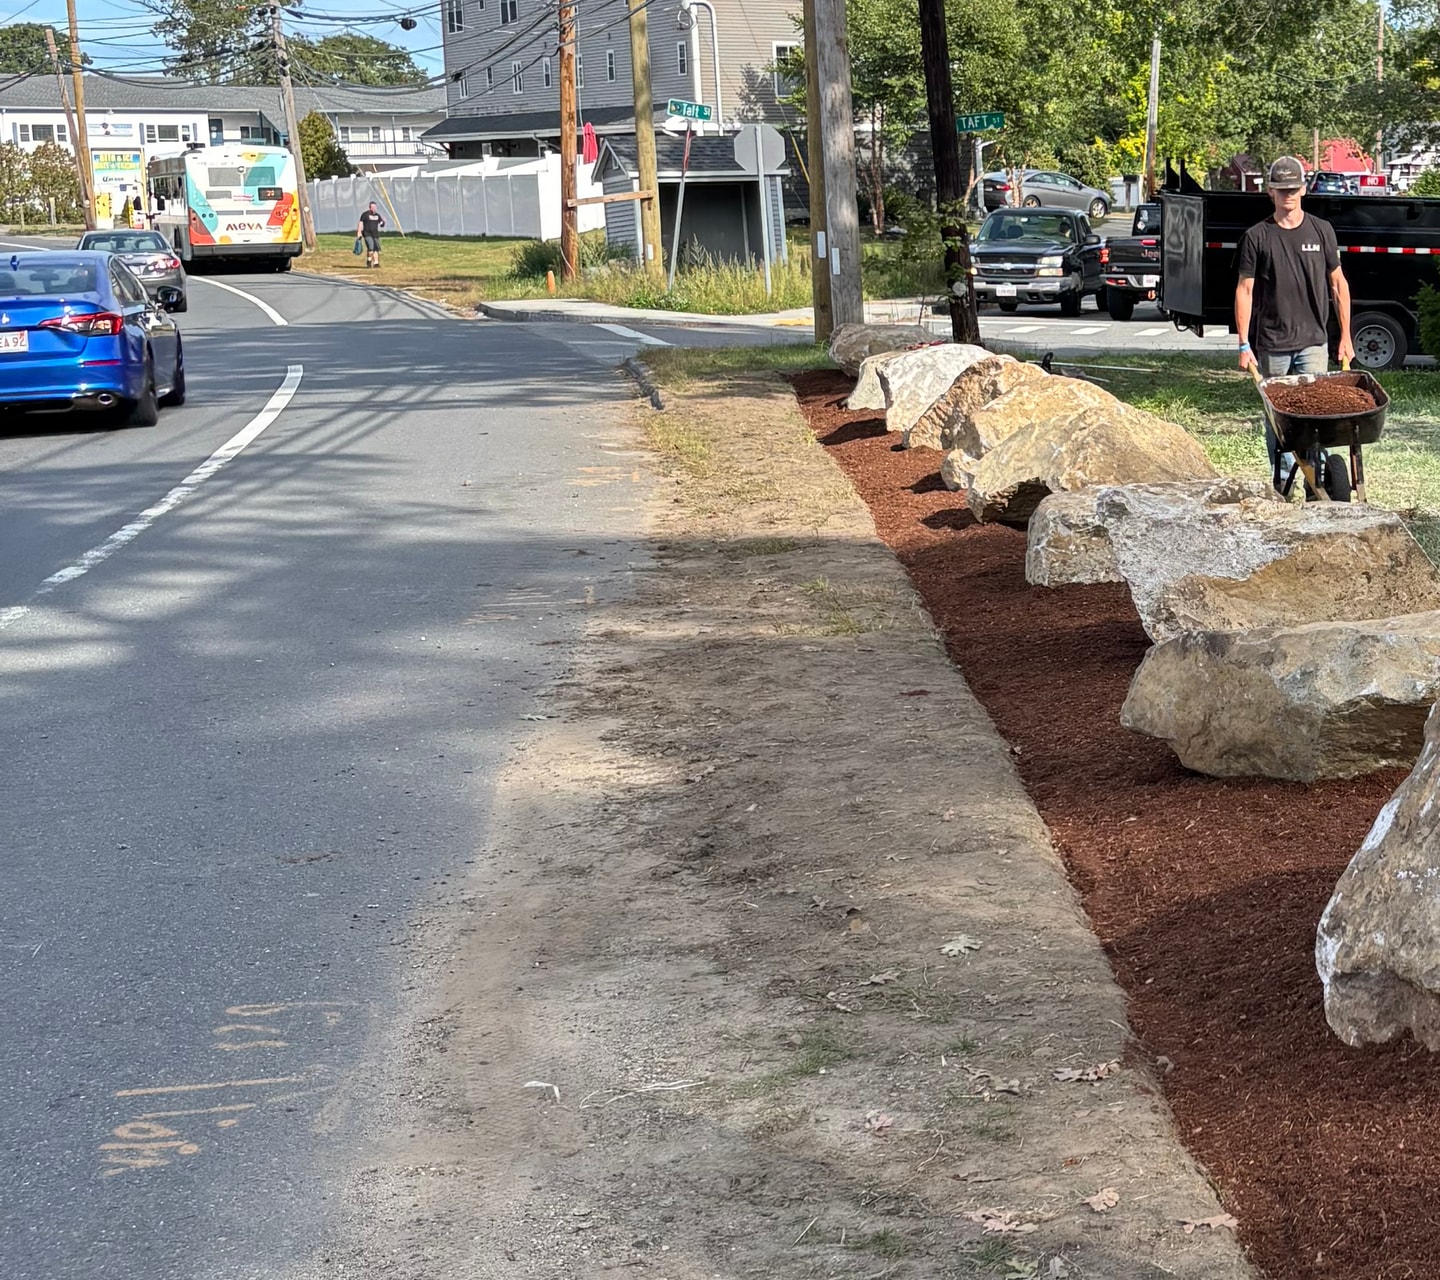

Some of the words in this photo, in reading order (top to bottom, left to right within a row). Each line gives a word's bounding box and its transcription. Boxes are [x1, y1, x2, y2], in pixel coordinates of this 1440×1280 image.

[960, 115, 988, 129] TAFT
[1366, 177, 1379, 186] NO
[1141, 249, 1160, 258] Jee
